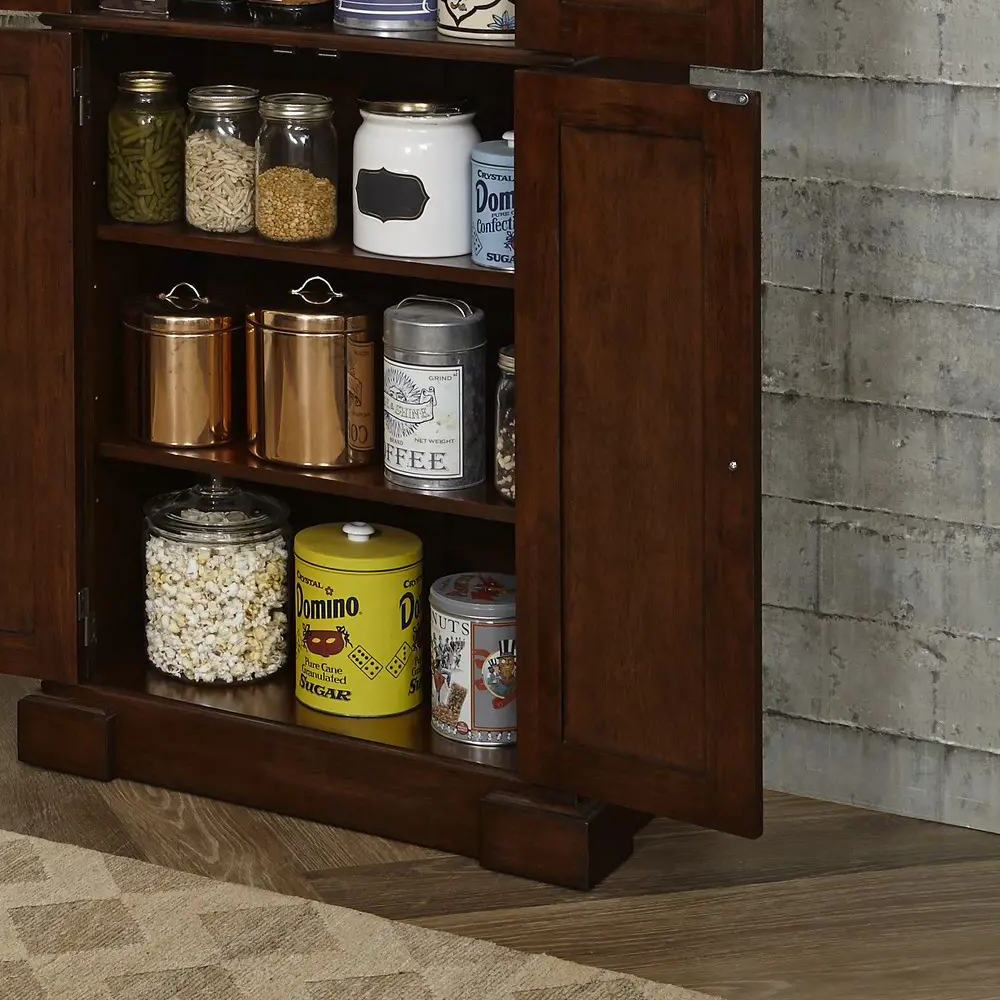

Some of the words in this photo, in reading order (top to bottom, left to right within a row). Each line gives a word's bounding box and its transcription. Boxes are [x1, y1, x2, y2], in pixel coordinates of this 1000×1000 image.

[384, 443, 447, 470] FFEE
[296, 582, 360, 620] Domino
[301, 663, 347, 685] Granulated
[321, 662, 343, 675] Cane
